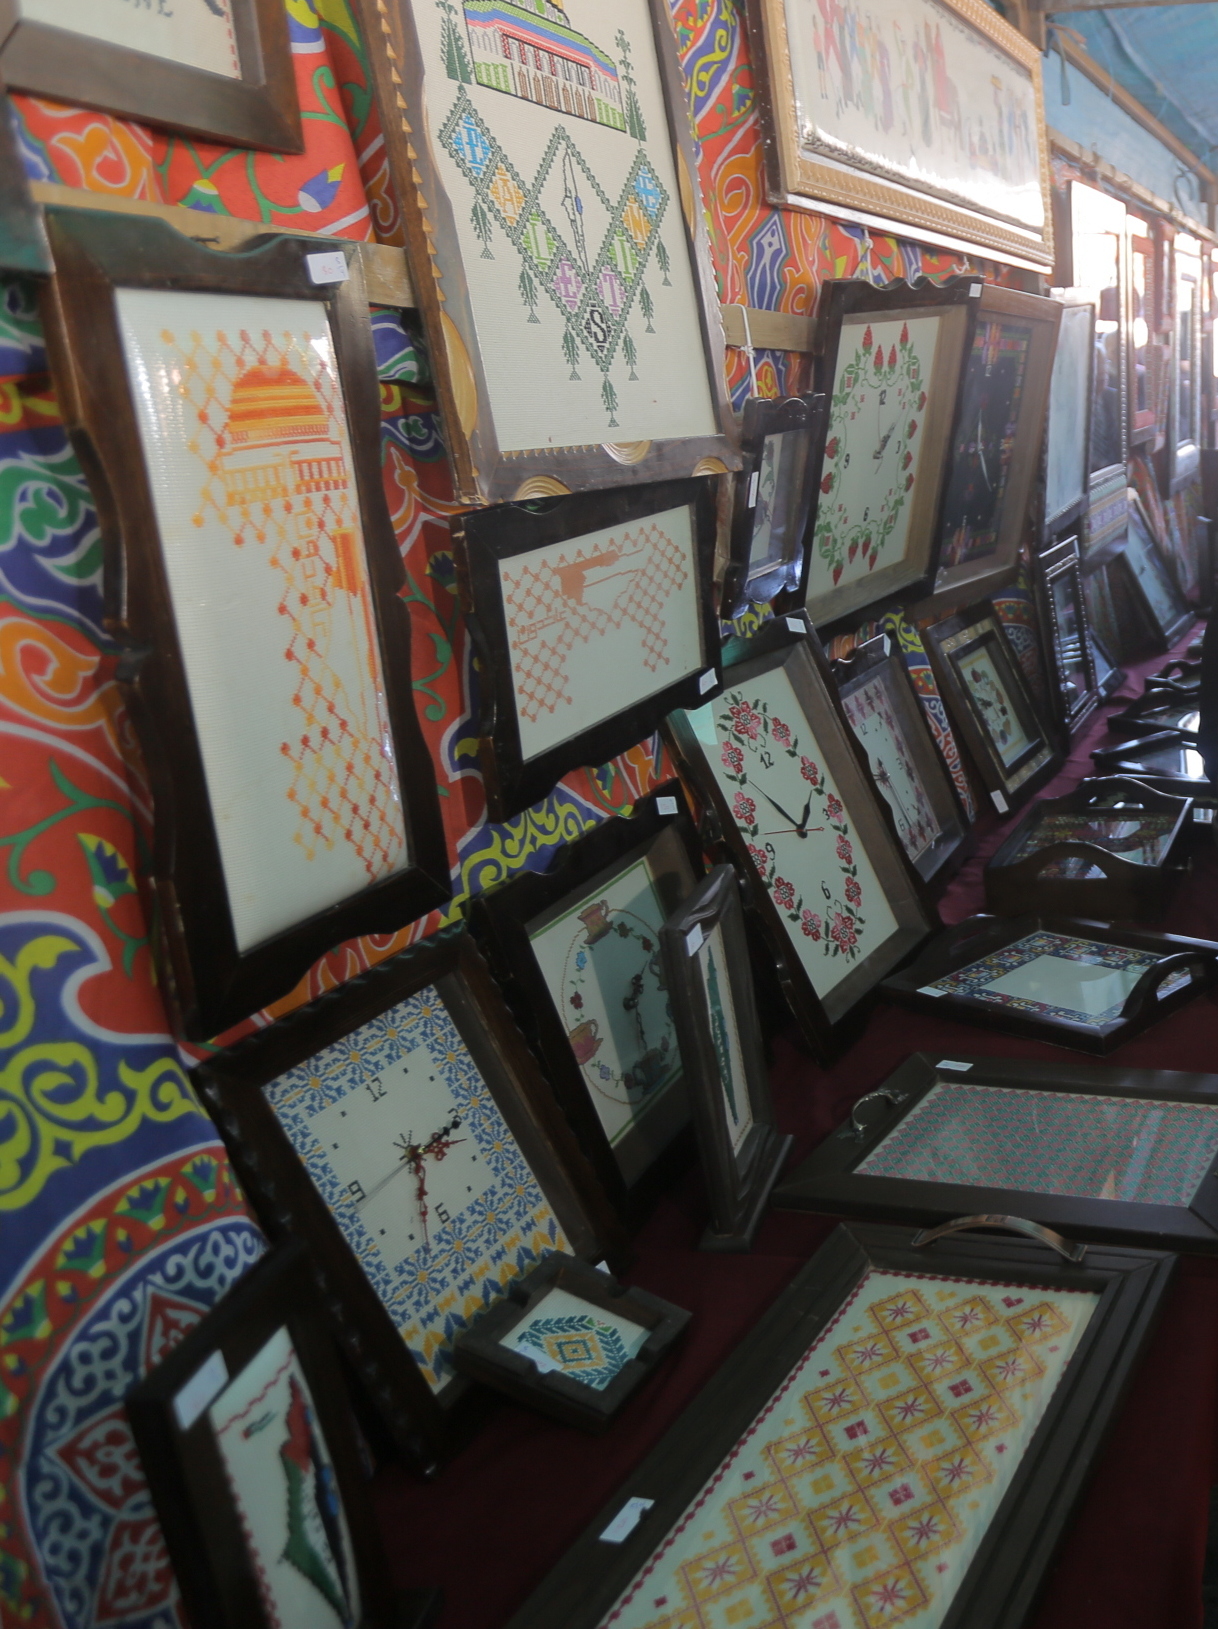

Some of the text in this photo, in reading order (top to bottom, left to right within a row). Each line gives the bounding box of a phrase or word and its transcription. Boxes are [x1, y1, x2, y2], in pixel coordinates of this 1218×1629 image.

[760, 751, 774, 769] 12
[822, 807, 831, 821] 3
[898, 818, 906, 832] 6
[764, 842, 776, 861] 9
[820, 880, 832, 900] 6
[365, 1076, 388, 1103] 12
[347, 1179, 367, 1203] 9
[434, 1202, 451, 1225] 6
